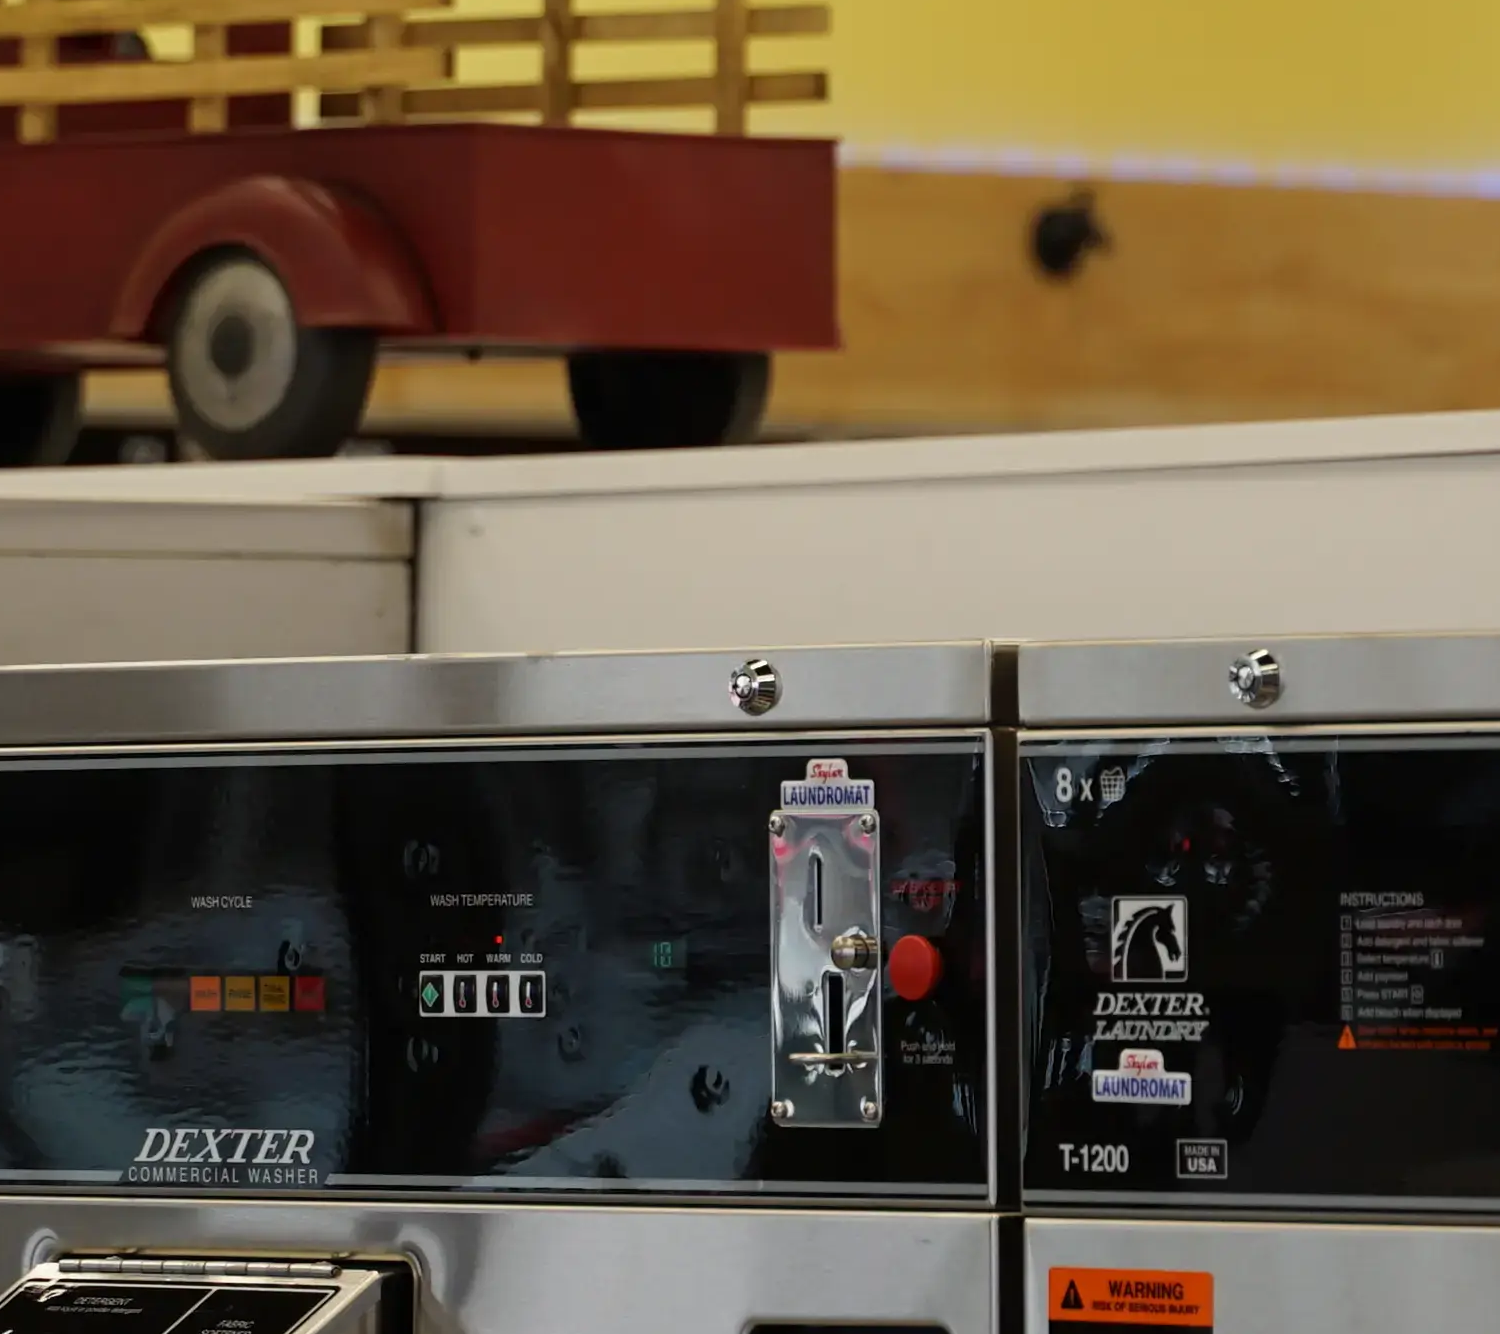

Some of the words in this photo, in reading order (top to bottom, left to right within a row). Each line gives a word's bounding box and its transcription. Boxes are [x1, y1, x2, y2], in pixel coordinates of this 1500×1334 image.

[1056, 768, 1072, 802] 8
[783, 785, 871, 807] LAUNDROMAT
[191, 896, 219, 909] WASH
[221, 896, 253, 909] CYCLE
[430, 894, 459, 907] WASH
[460, 894, 533, 908] TEMPERATURE
[1340, 892, 1424, 907] INSTRUCTIONS
[419, 953, 446, 964] START
[456, 953, 474, 964] HOT
[486, 953, 511, 964] WARM
[520, 953, 543, 964] COLD
[1093, 993, 1204, 1017] DEXTER
[1093, 1020, 1209, 1042] LAUNDRY
[1095, 1075, 1187, 1099] LAUNDROMAT
[134, 1128, 315, 1165] DEXTER
[1060, 1144, 1129, 1173] T-1200
[1187, 1157, 1217, 1173] USA
[128, 1166, 240, 1184] COMMERCIAL
[247, 1167, 319, 1185] WASHER
[1108, 1279, 1185, 1300] WARNING
